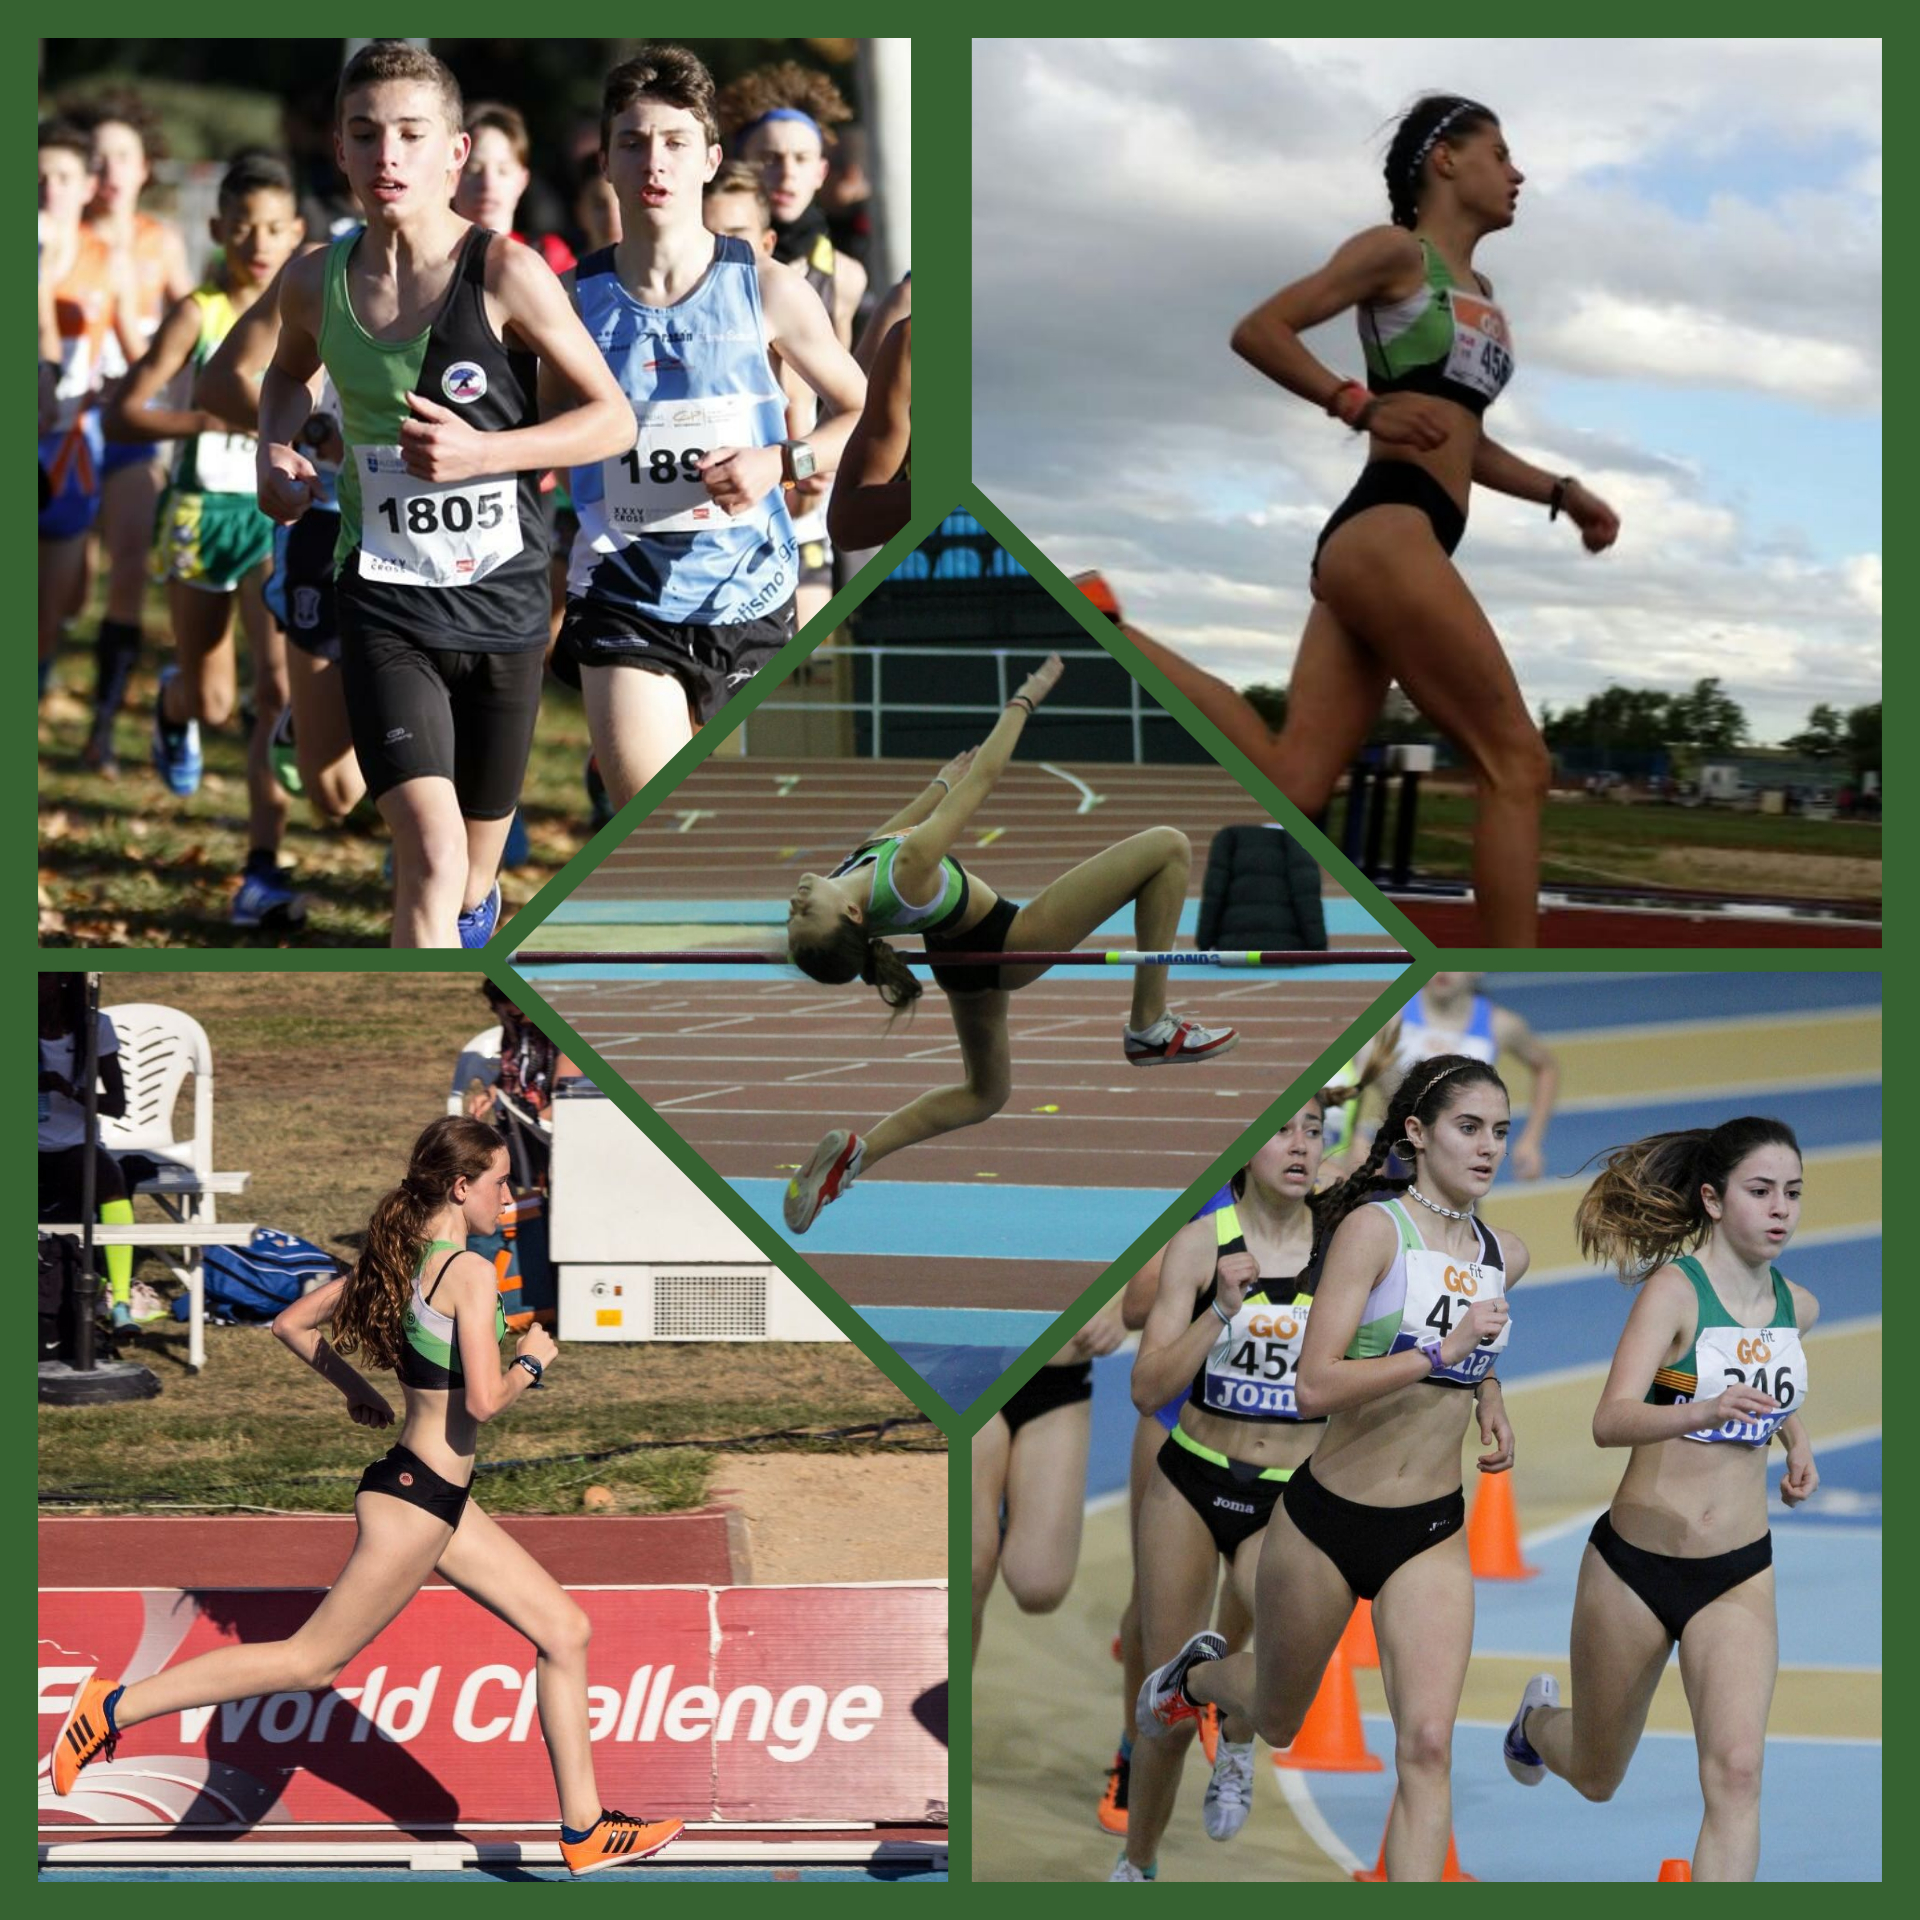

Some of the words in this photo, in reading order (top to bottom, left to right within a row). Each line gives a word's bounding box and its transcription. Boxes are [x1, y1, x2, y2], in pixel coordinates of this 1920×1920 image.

[378, 491, 504, 534] 1805
[613, 507, 645, 516] XXXV
[614, 515, 645, 523] CROSS
[370, 564, 406, 573] CROSS
[1469, 1263, 1484, 1279] fit
[1443, 1265, 1478, 1297] GO
[1292, 1306, 1308, 1320] fit
[1248, 1314, 1299, 1340] GO
[1760, 1329, 1775, 1343] fit
[1736, 1338, 1771, 1365] GO
[1212, 1496, 1255, 1515] Joma
[180, 1665, 442, 1743] World
[452, 1664, 883, 1762] Challenge
